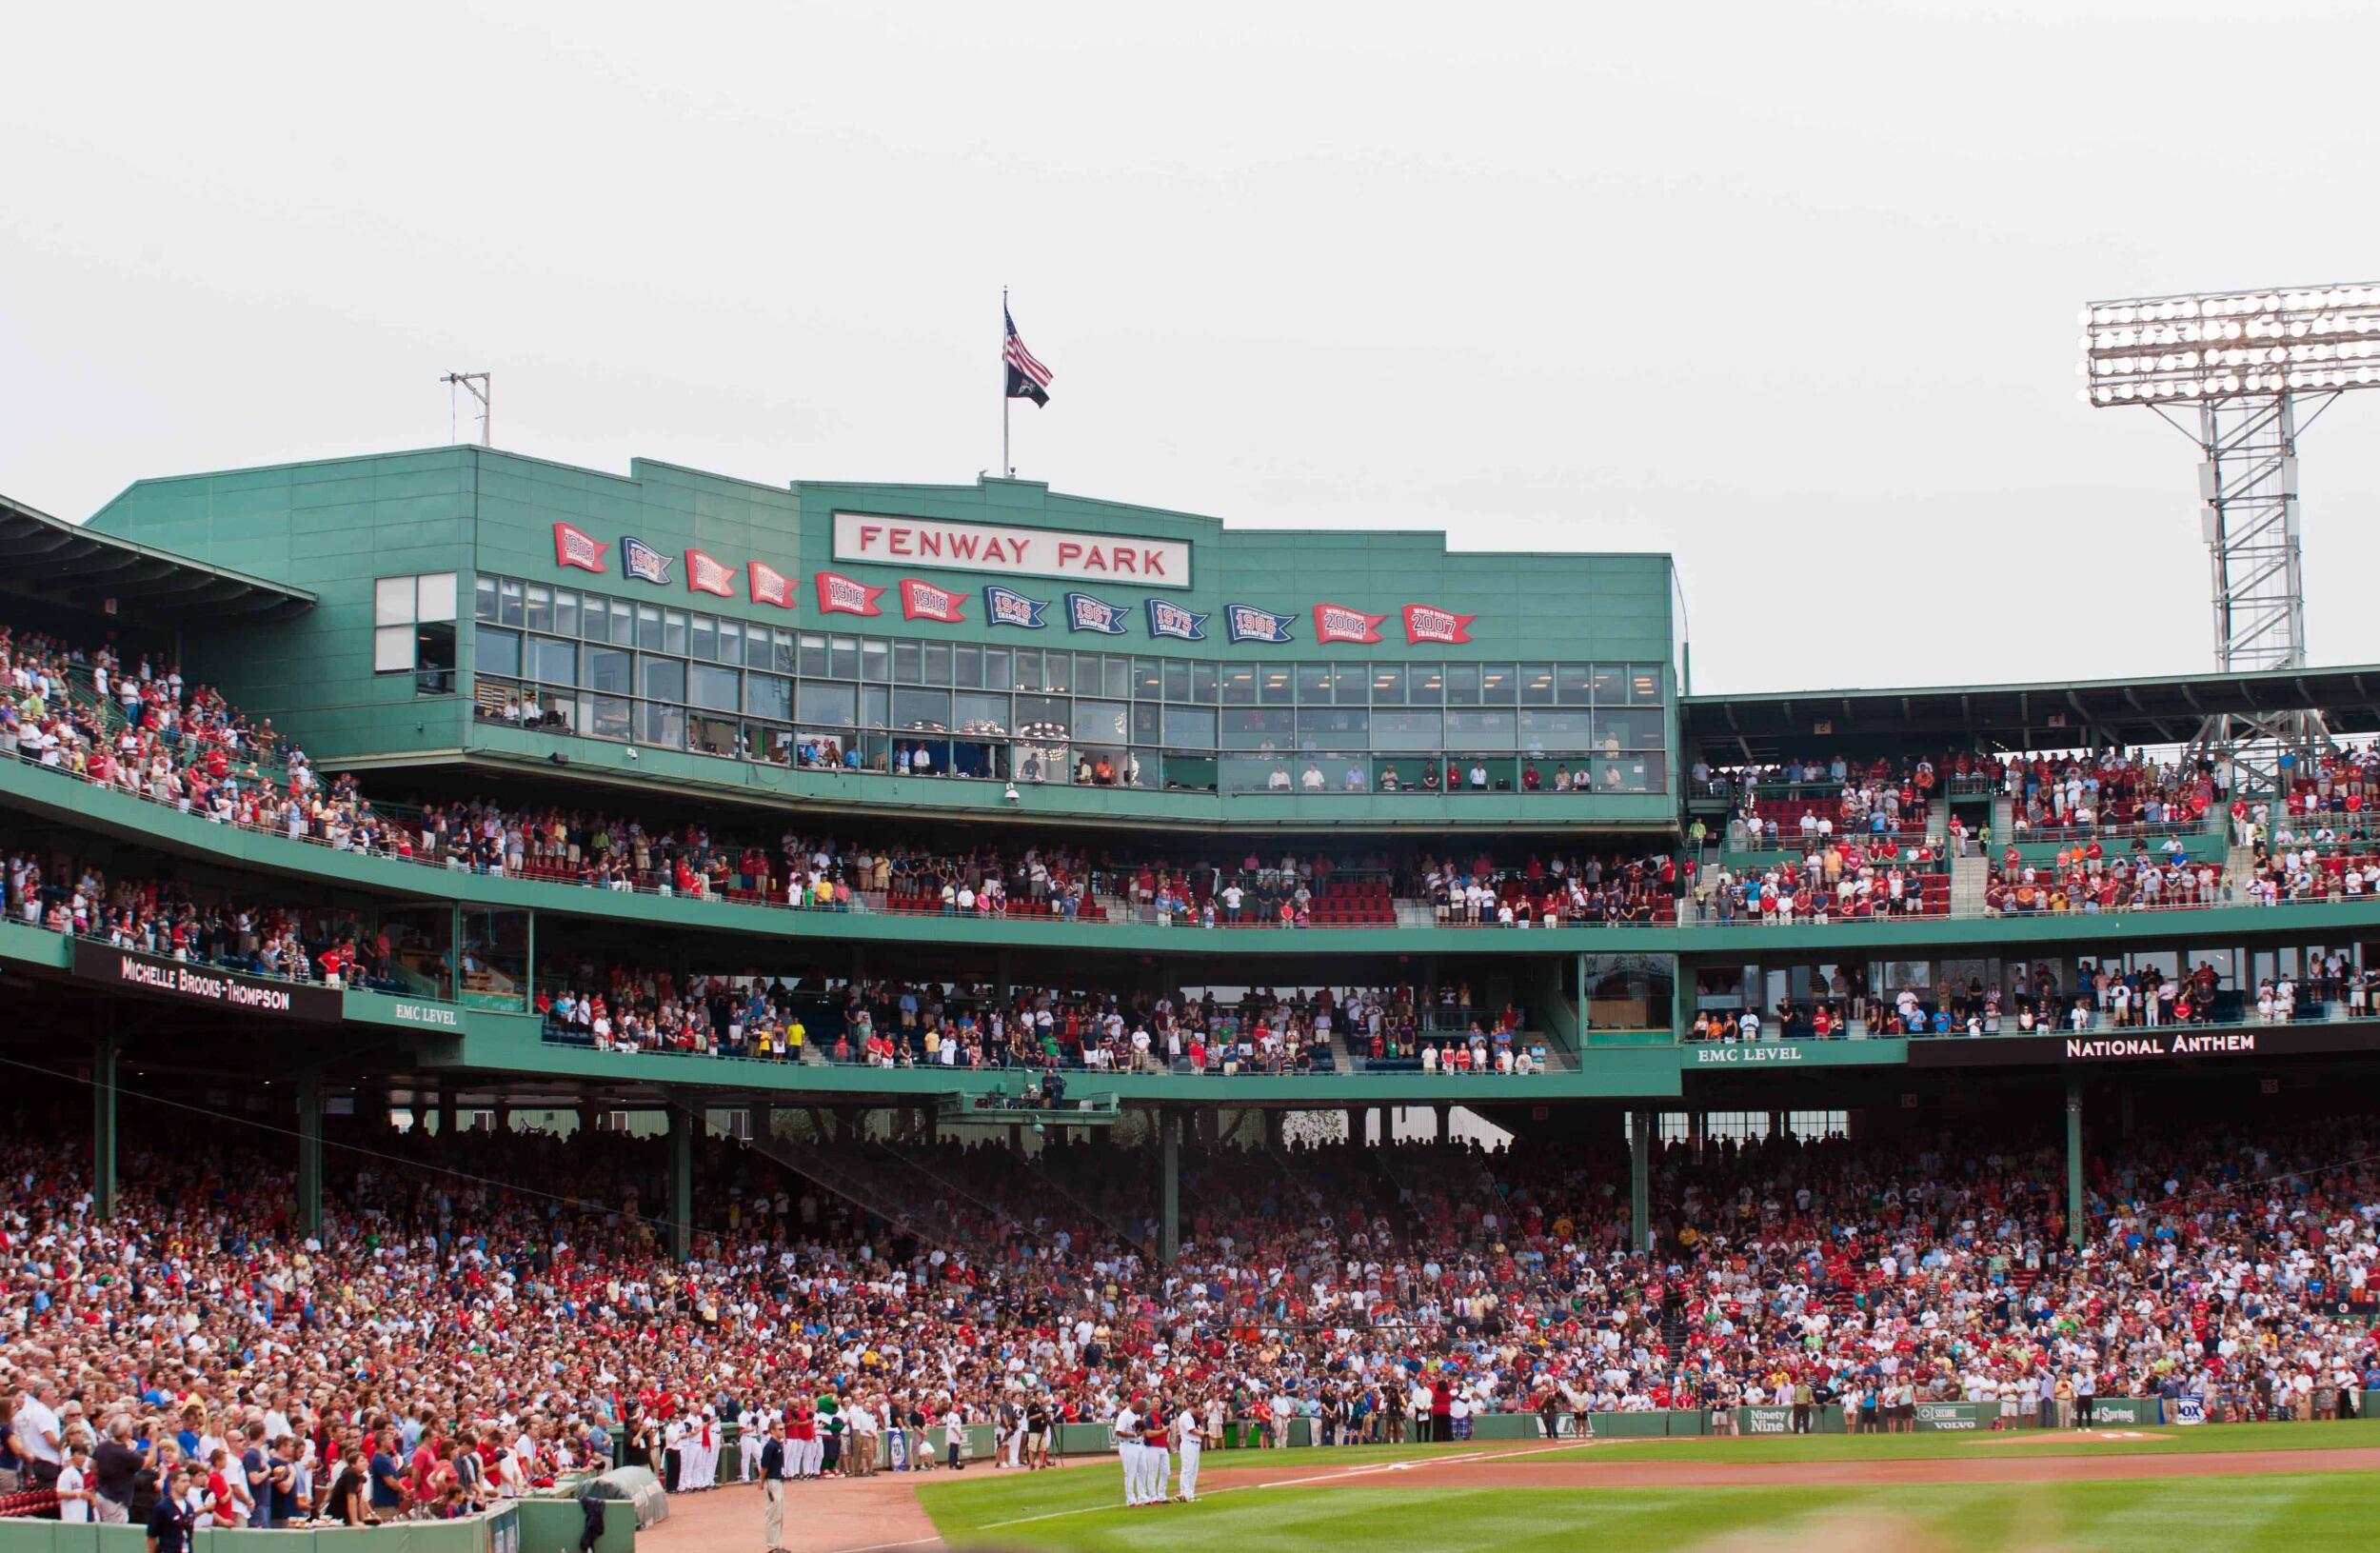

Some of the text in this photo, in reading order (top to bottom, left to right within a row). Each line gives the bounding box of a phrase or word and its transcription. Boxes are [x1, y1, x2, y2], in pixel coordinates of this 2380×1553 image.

[860, 525, 1165, 576] FENWAY PARK
[829, 583, 864, 607] 1916
[913, 589, 948, 612] 1918
[995, 595, 1031, 619] 1946
[1076, 603, 1112, 626] 1967
[1157, 607, 1192, 631] 1975
[1236, 613, 1277, 634] 1986
[1324, 613, 1366, 634] 2004
[1412, 613, 1456, 635] 2007
[1160, 624, 1190, 637] CHAMPIONS
[1240, 628, 1274, 640] CHAMPIONS
[1329, 628, 1363, 640] CHAMPIONS
[1417, 629, 1454, 641] CHAMPIONS
[122, 955, 176, 989] MICHELLE
[396, 1004, 457, 1025] EMC LEVEL
[1697, 1047, 1802, 1062] EMC LEVEL
[2067, 1034, 2255, 1058] NATIONAL ANTHEM
[1751, 1409, 1786, 1424] Ninety
[2101, 1406, 2135, 1423] Spring
[1751, 1420, 1785, 1432] Nine
